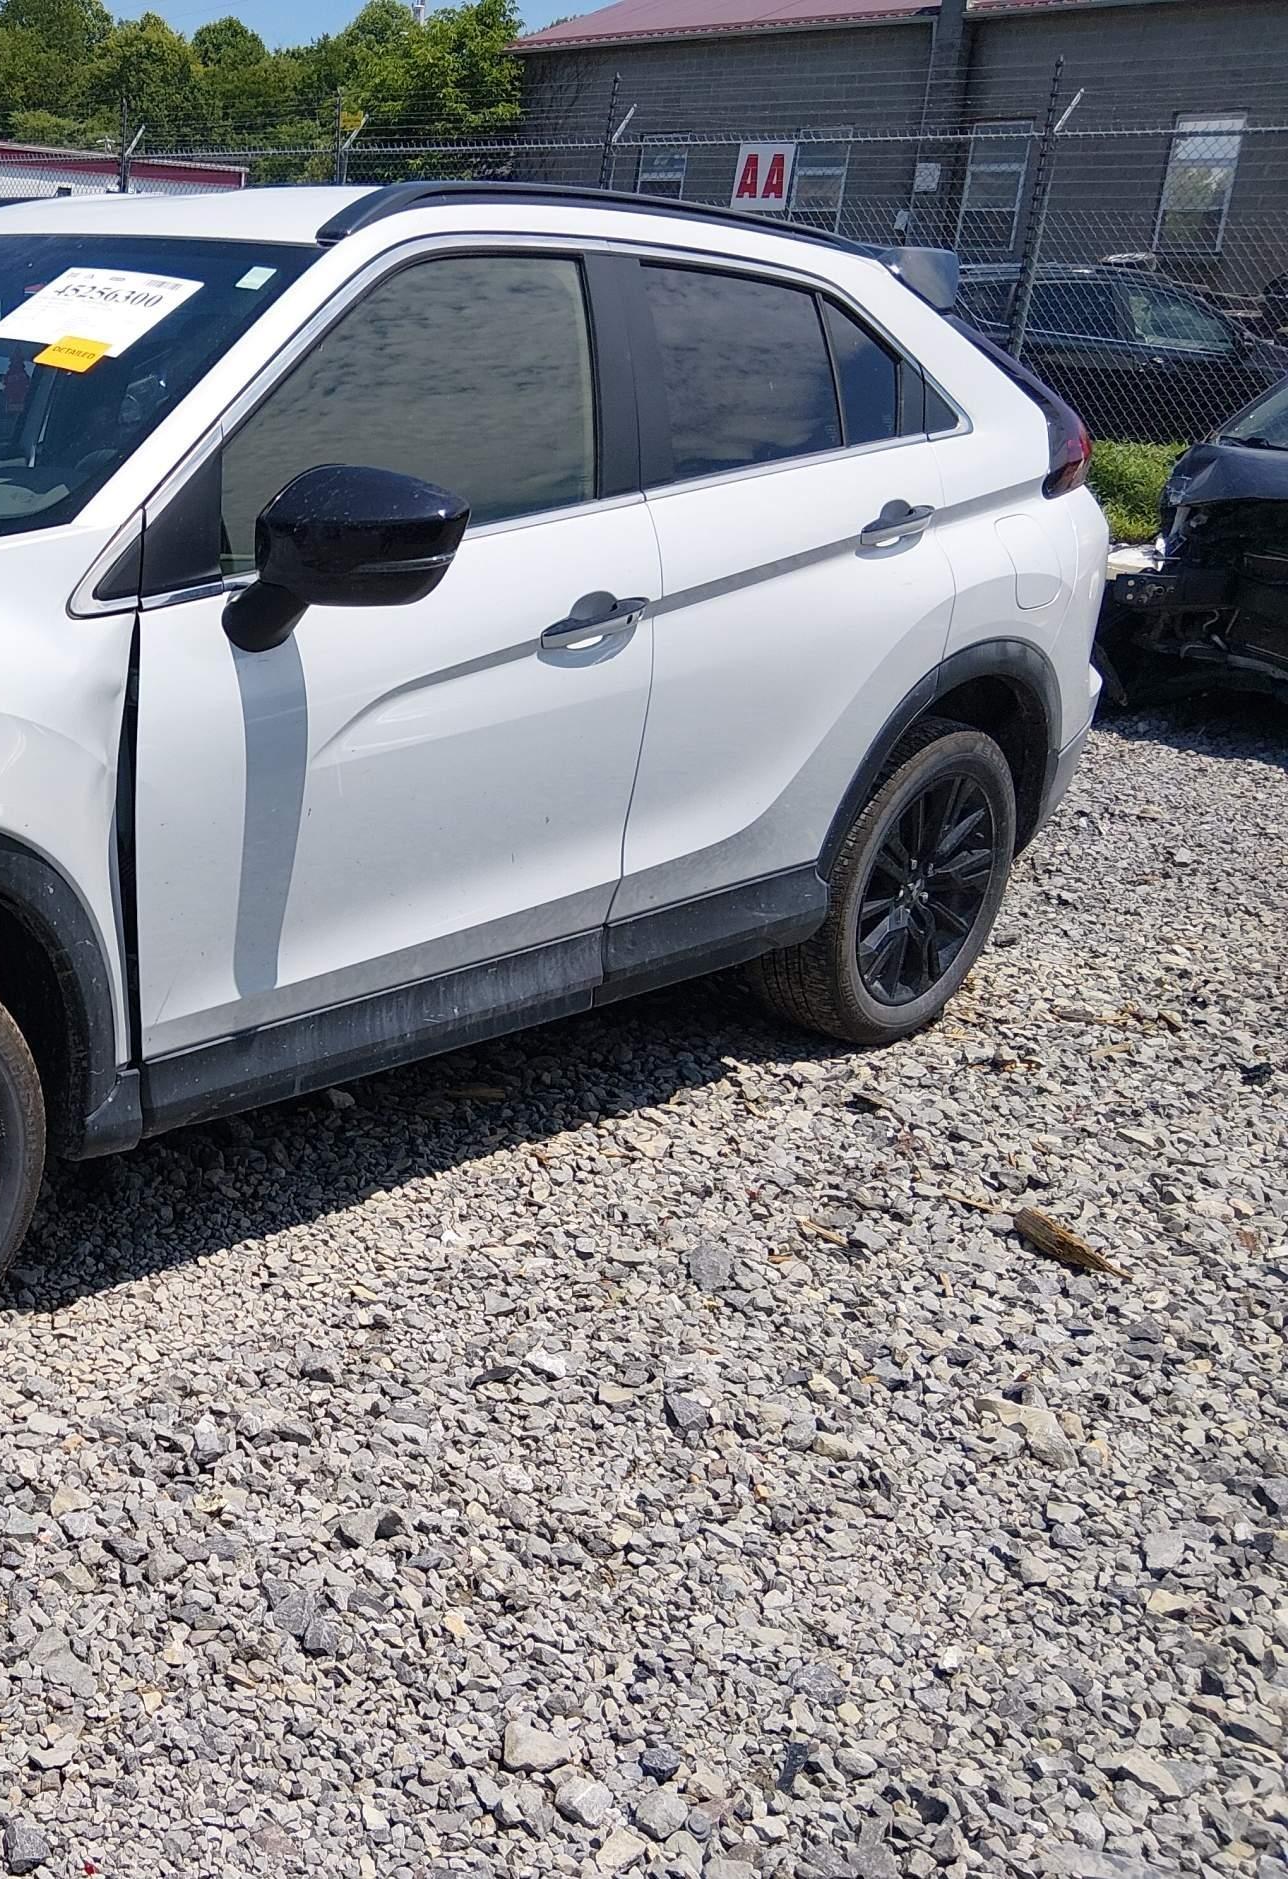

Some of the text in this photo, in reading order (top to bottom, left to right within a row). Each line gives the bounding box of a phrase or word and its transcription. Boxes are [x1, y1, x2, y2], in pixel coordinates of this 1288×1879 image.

[735, 153, 785, 199] AA
[54, 283, 164, 308] 45256300
[52, 345, 96, 360] DETAILED
